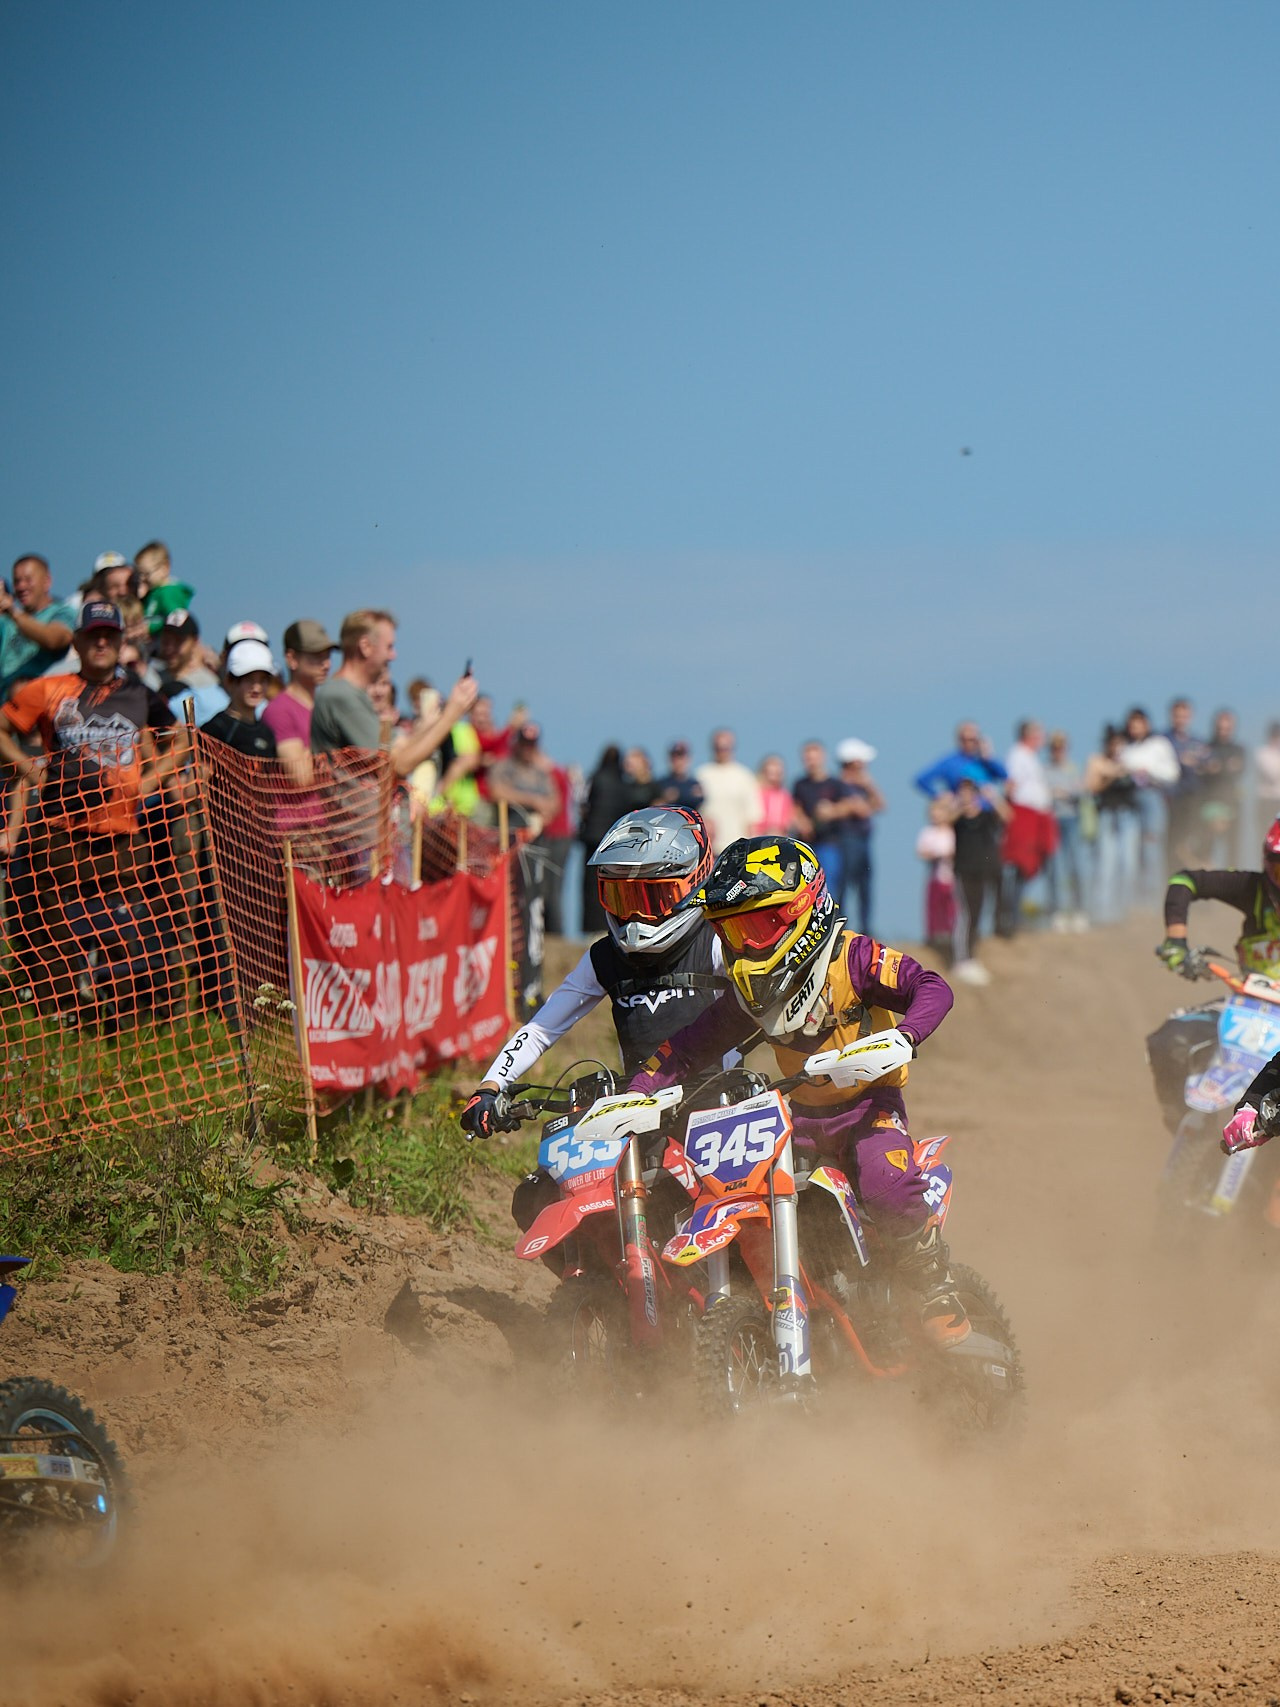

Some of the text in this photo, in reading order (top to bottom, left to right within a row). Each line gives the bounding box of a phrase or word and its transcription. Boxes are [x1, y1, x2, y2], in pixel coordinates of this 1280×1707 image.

[785, 972, 816, 1022] LEATT
[838, 1042, 892, 1061] ACERBIS
[580, 1098, 659, 1126] ACERBIS
[695, 1117, 777, 1178] 345
[584, 1172, 593, 1183] OF
[593, 1168, 607, 1180] LIFE
[725, 1181, 748, 1193] KTM
[578, 1199, 615, 1213] GASGAS
